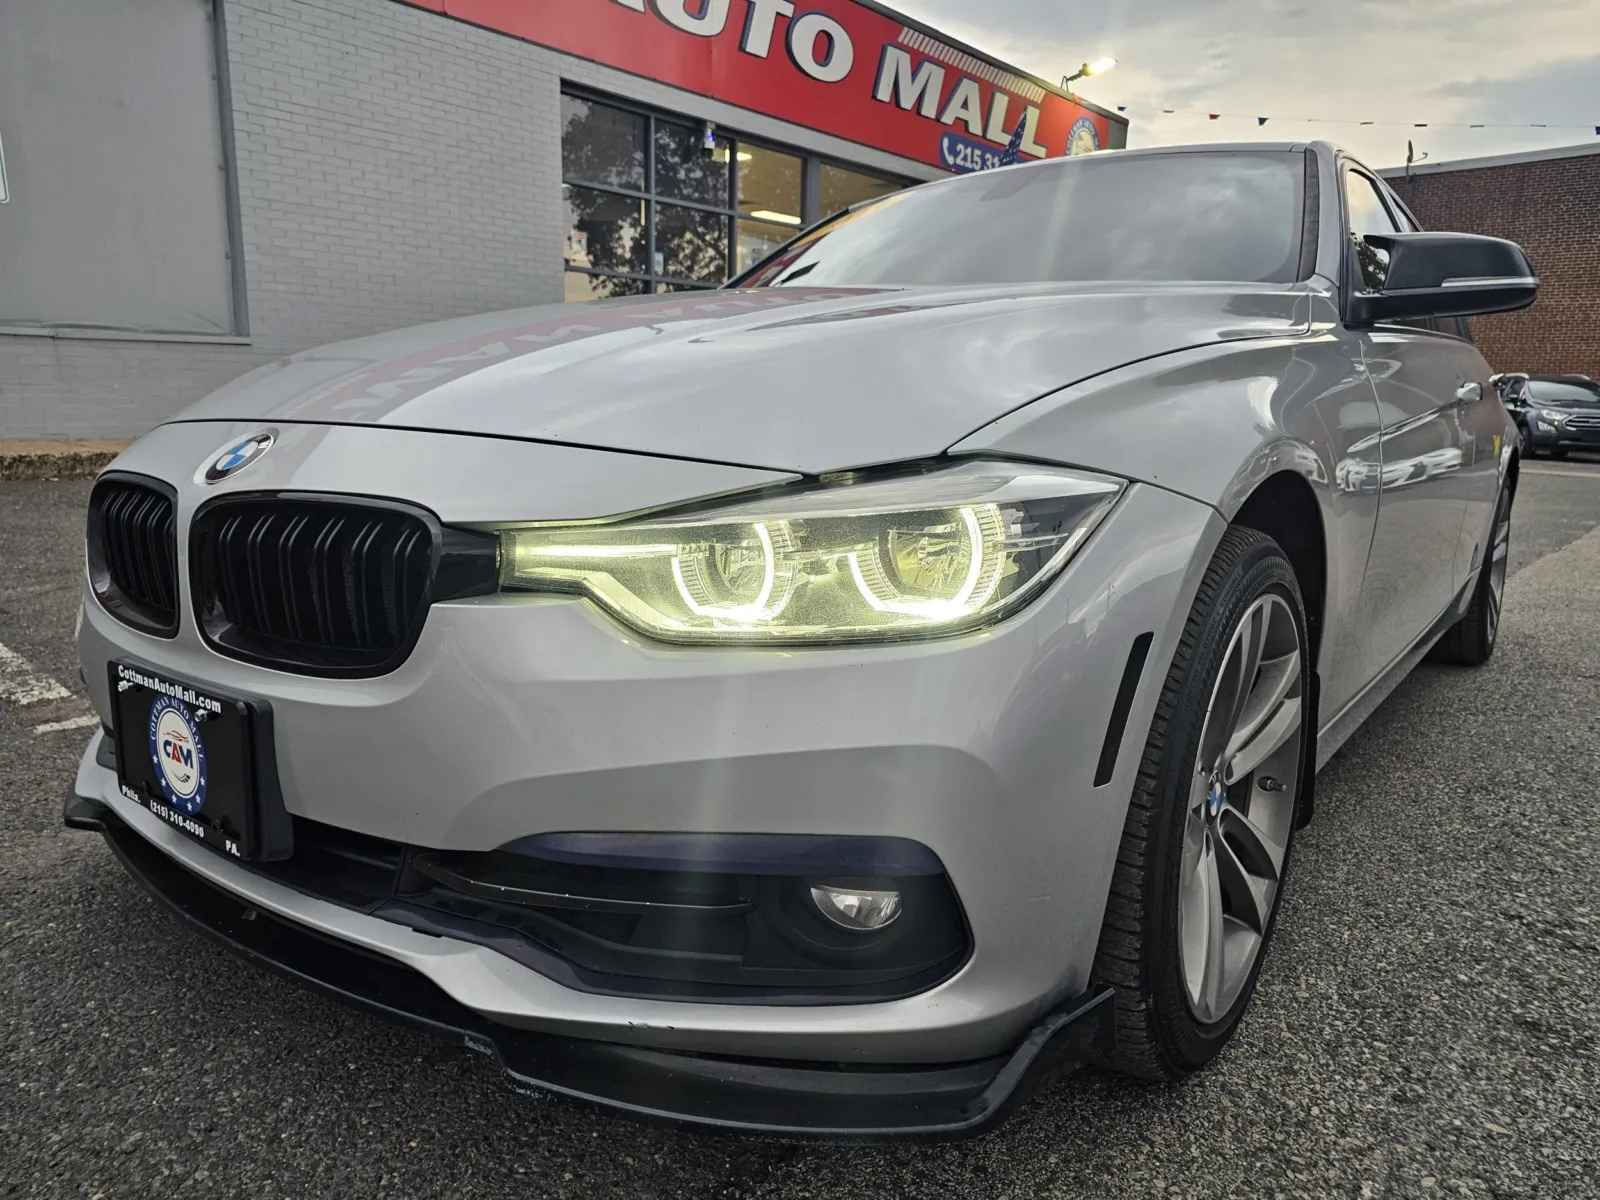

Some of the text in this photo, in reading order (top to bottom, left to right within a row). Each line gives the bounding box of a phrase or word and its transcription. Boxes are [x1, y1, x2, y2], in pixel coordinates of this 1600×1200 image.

[608, 0, 1048, 159] UTO MALL
[955, 143, 982, 171] 215
[118, 665, 222, 714] CottmanAutoMall.com
[150, 695, 170, 740] COTTMAN
[170, 696, 189, 720] AUTO
[121, 785, 141, 804] Phila.
[150, 799, 204, 838] (215) 310-4090
[225, 839, 241, 857] PA.
